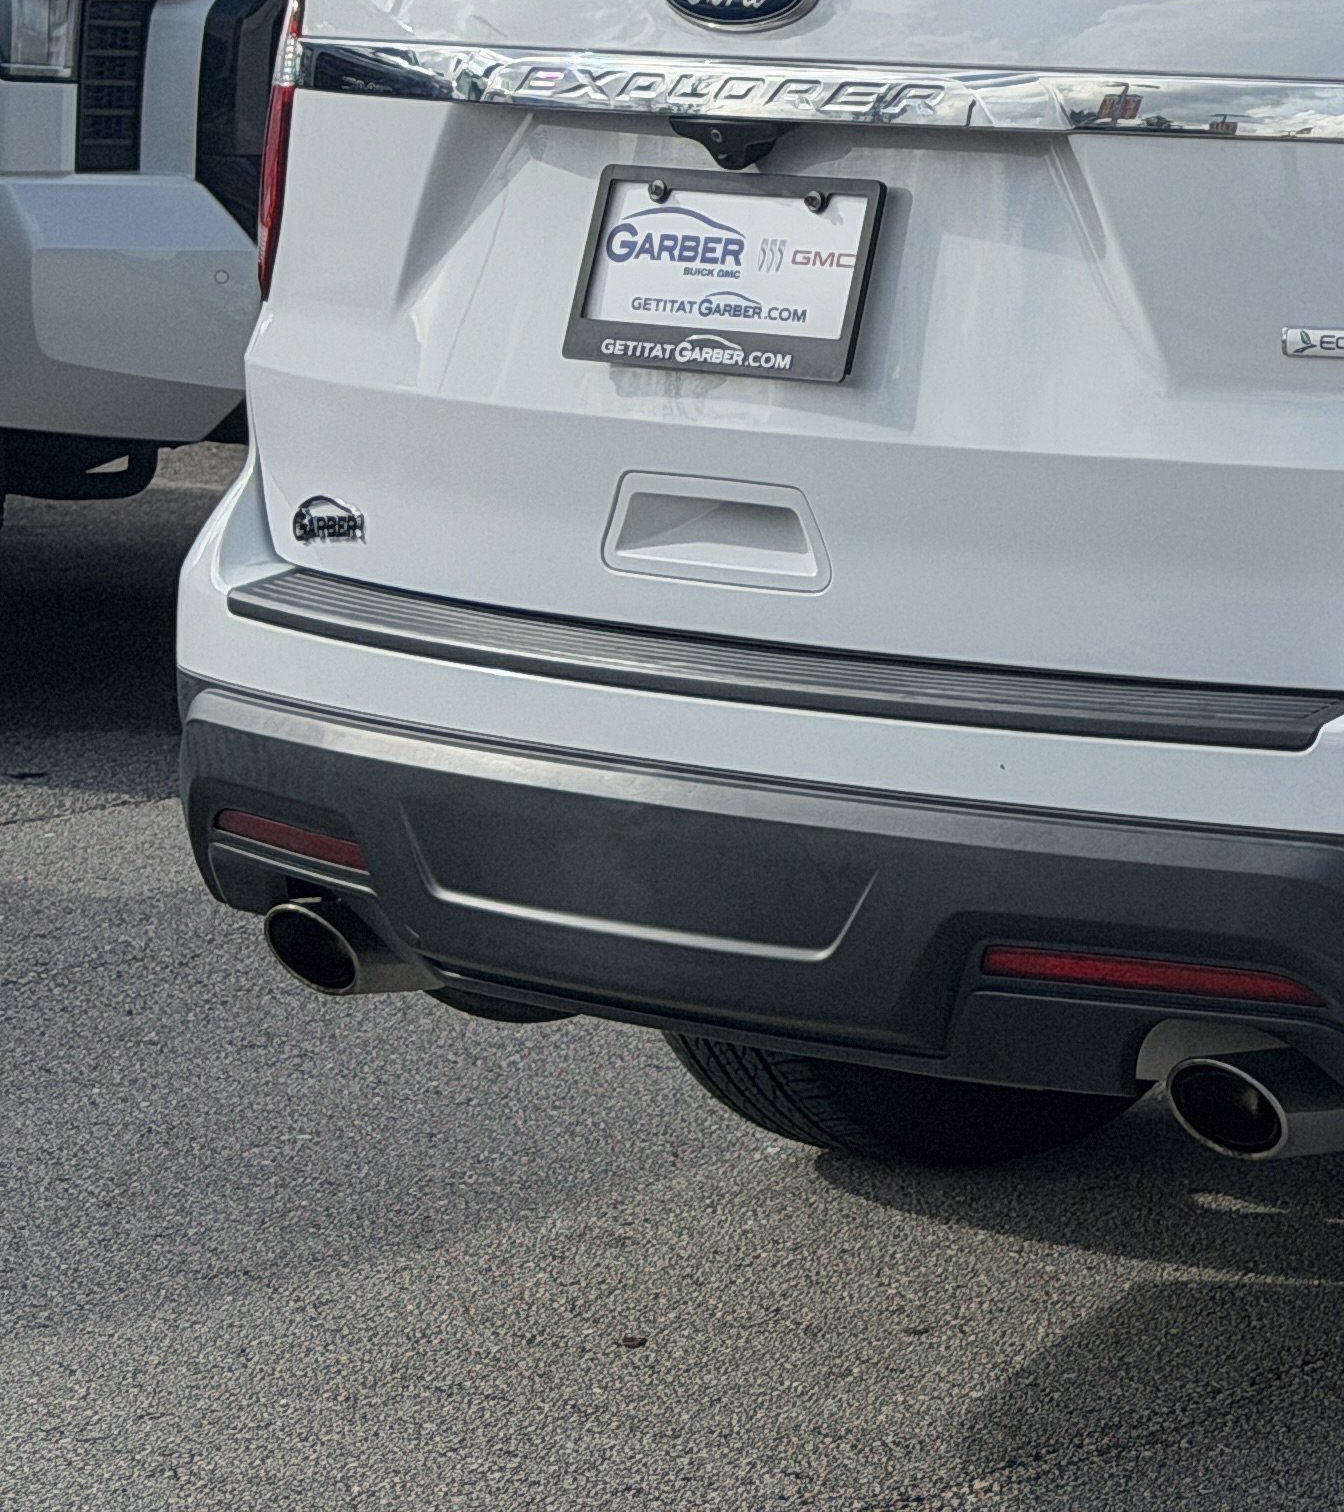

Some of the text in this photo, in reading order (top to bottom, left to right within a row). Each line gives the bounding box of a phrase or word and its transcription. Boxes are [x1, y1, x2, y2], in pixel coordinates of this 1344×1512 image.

[512, 65, 948, 116] EXPLORER
[606, 222, 746, 266] GARBER
[791, 249, 857, 269] GMC
[683, 266, 741, 279] BUICK GMC
[293, 506, 366, 544] GARBER
